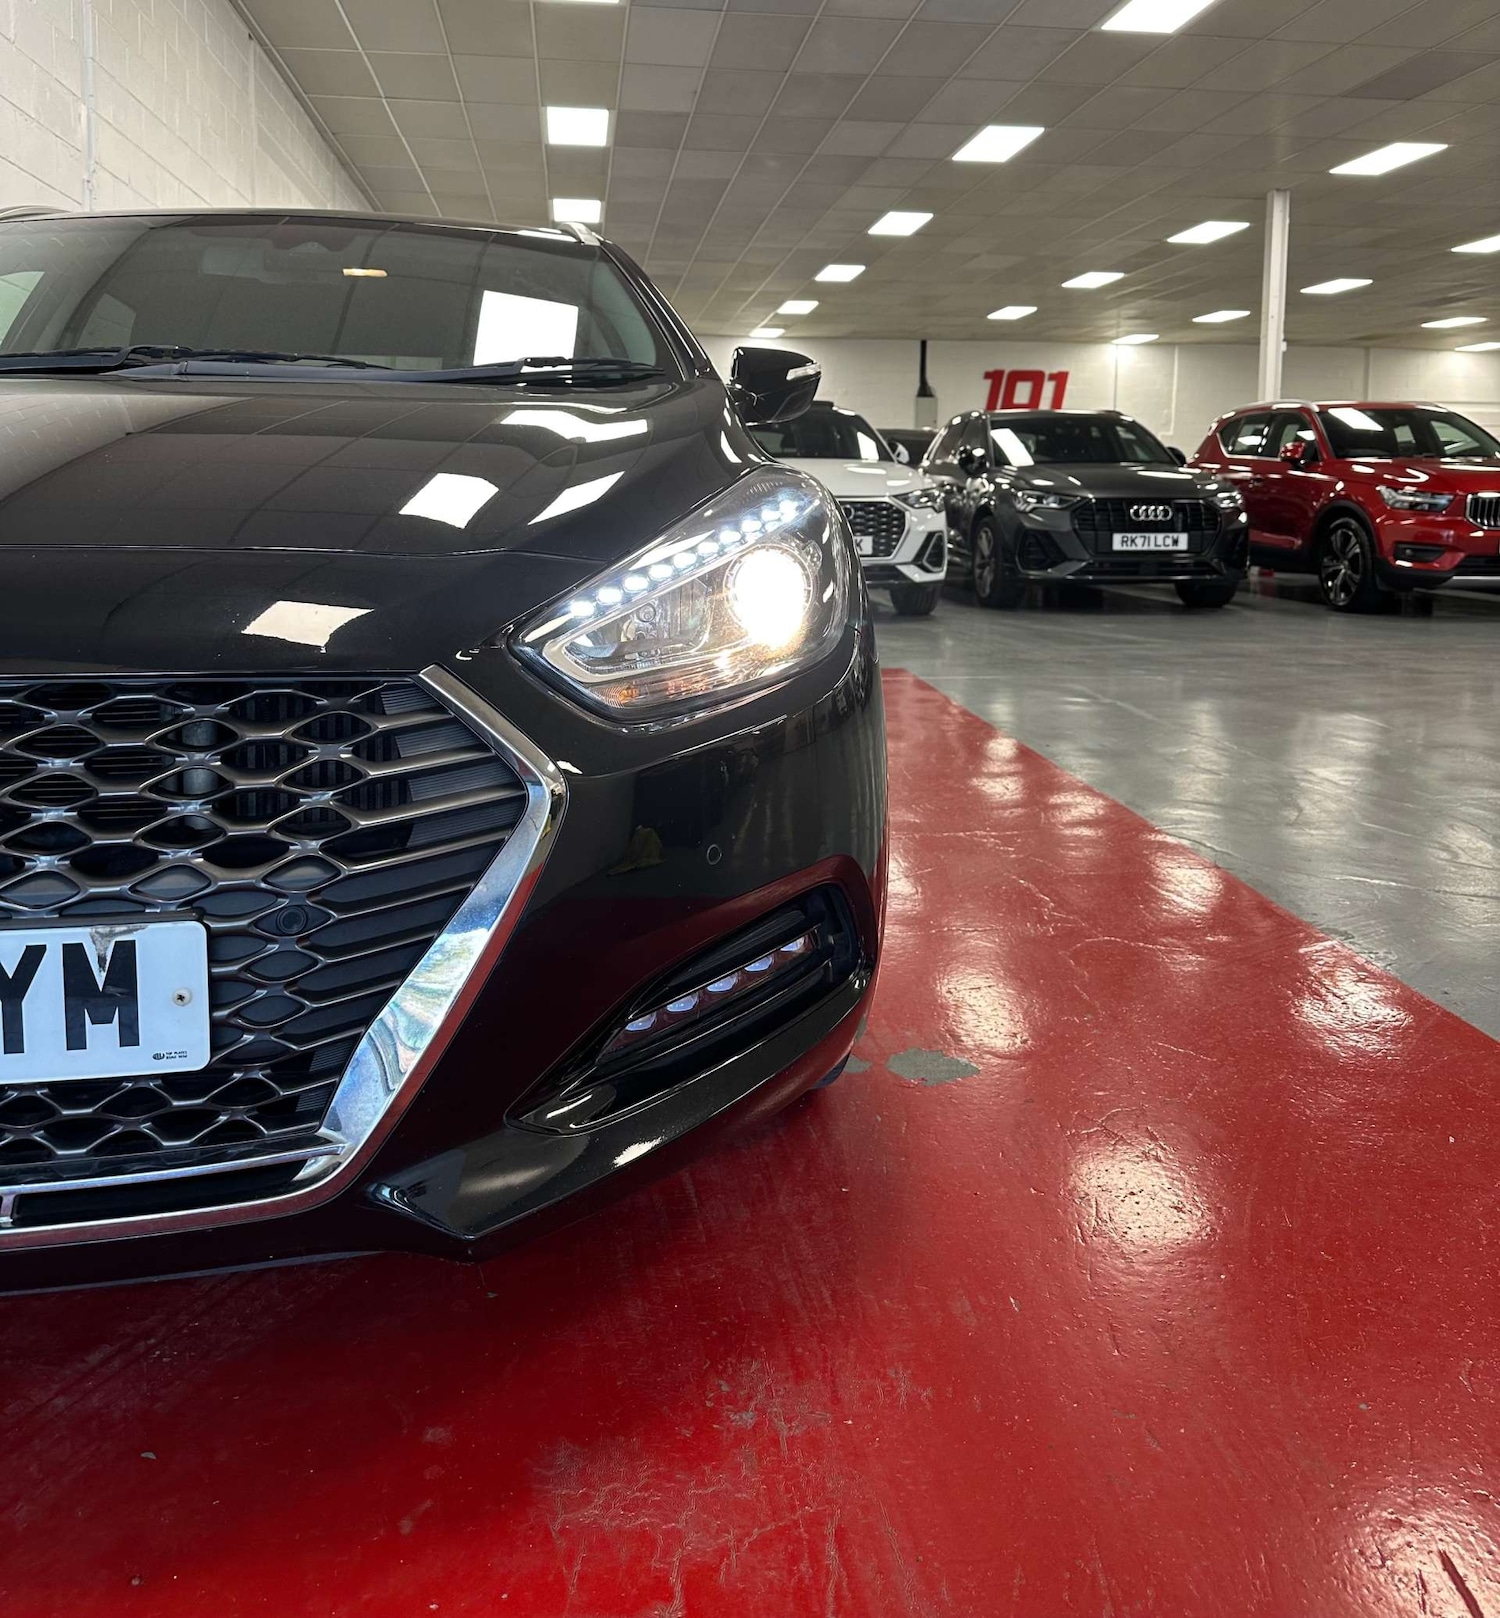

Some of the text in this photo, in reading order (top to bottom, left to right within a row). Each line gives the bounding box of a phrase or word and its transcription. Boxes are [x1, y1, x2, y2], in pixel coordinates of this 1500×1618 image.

[983, 369, 1069, 411] 101
[1120, 535, 1180, 548] RK71 LCW
[0, 939, 140, 1055] YM
